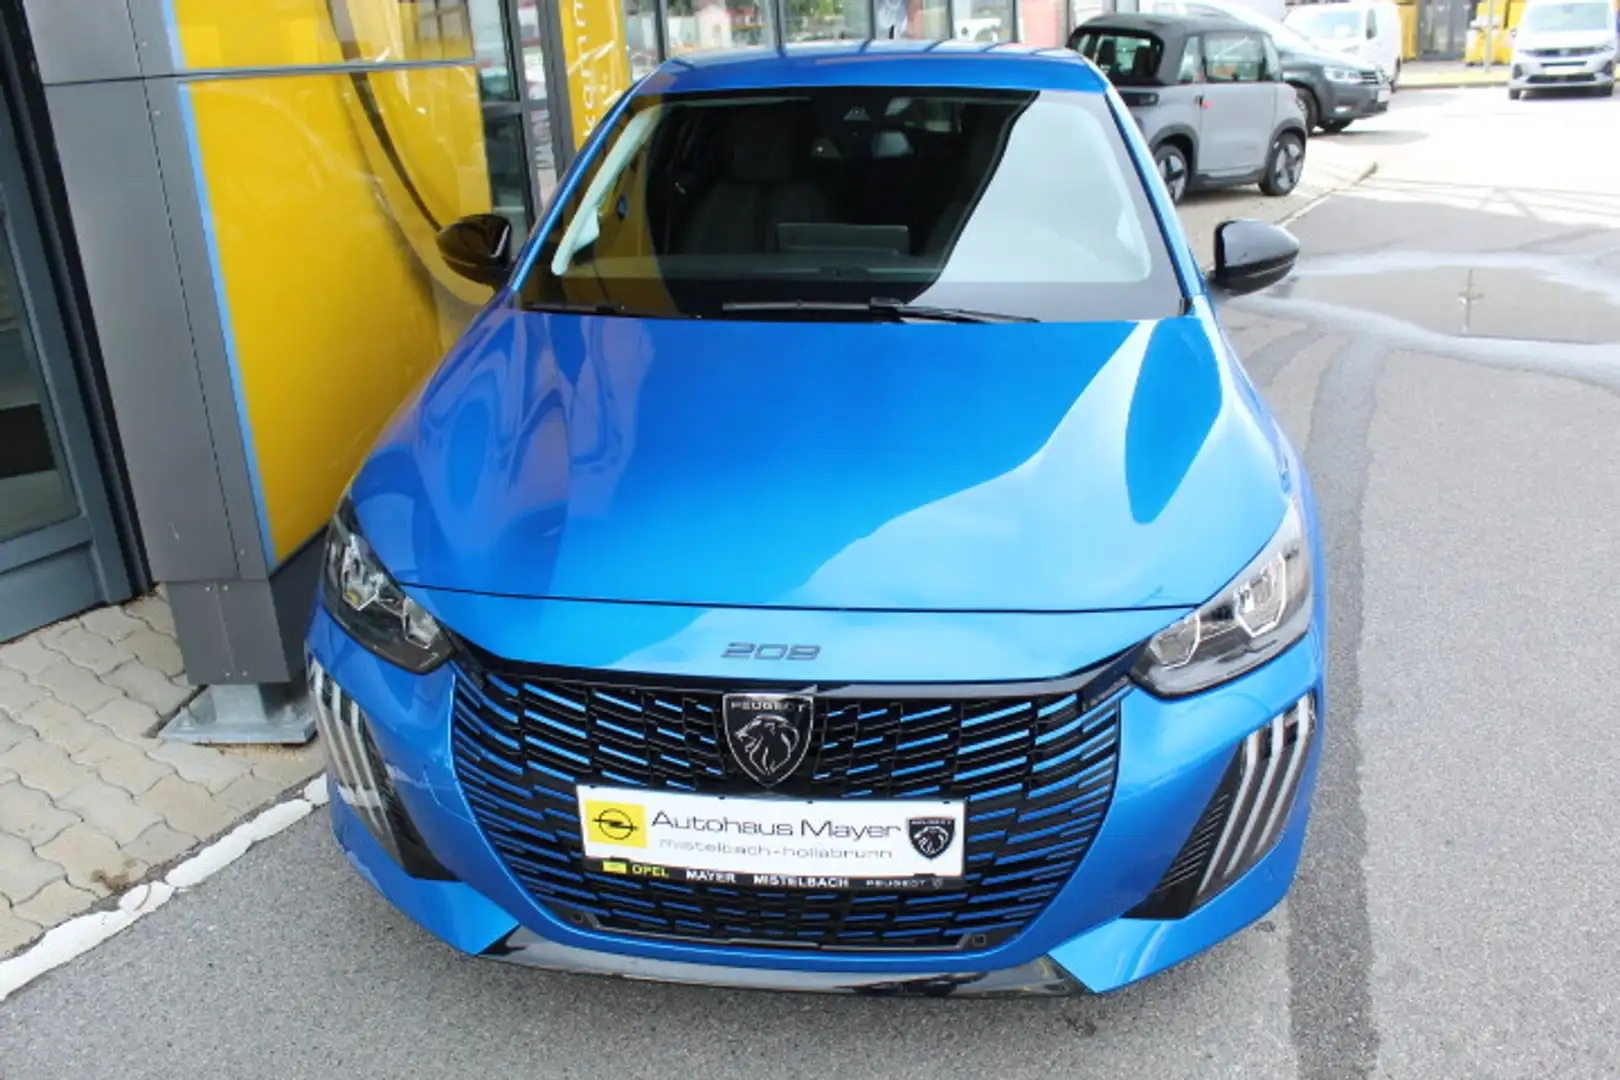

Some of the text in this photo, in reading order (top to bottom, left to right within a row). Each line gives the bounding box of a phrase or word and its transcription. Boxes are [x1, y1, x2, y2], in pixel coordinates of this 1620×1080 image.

[721, 642, 821, 660] 208
[651, 810, 901, 842] Autohaus Mayer
[632, 864, 926, 888] OPEL MAYER MISTELBACH PEUGEOT
